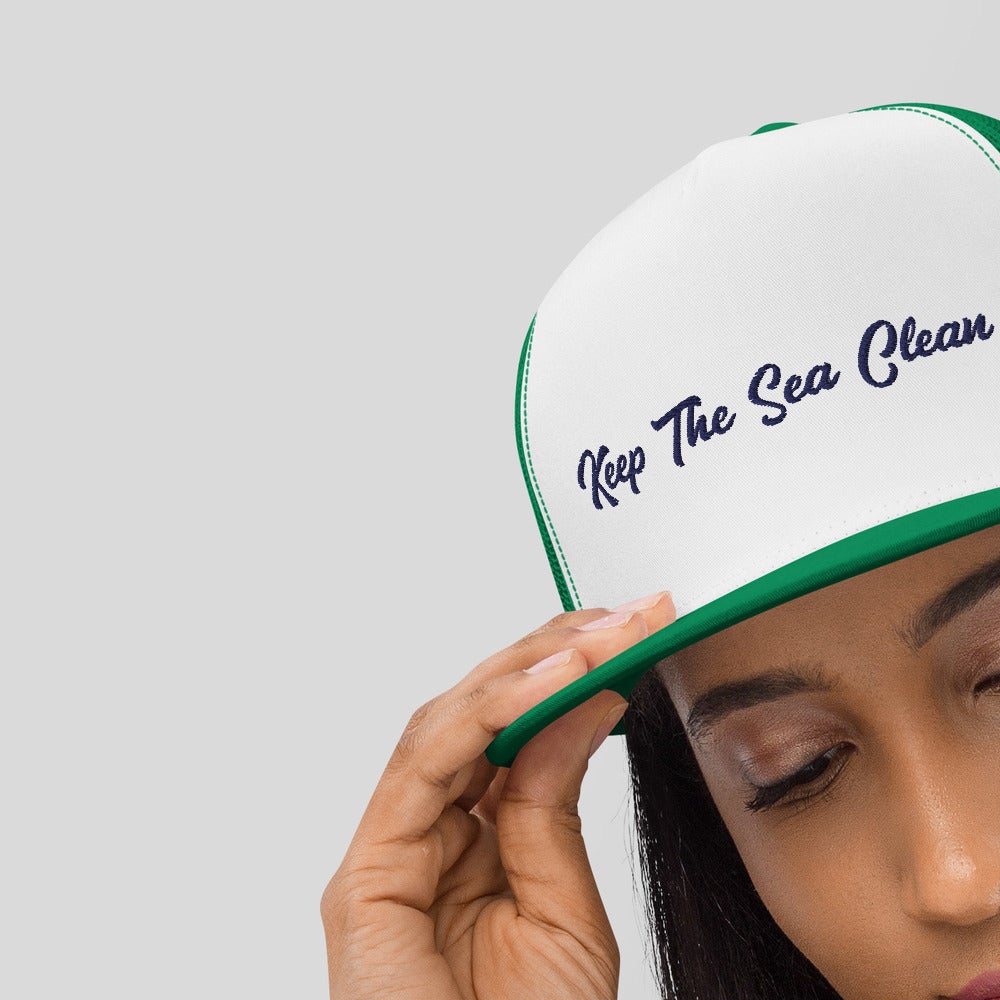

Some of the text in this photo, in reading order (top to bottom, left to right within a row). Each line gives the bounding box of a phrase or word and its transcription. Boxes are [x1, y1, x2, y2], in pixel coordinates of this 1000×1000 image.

[577, 313, 995, 510] Keep The Sea Clean
